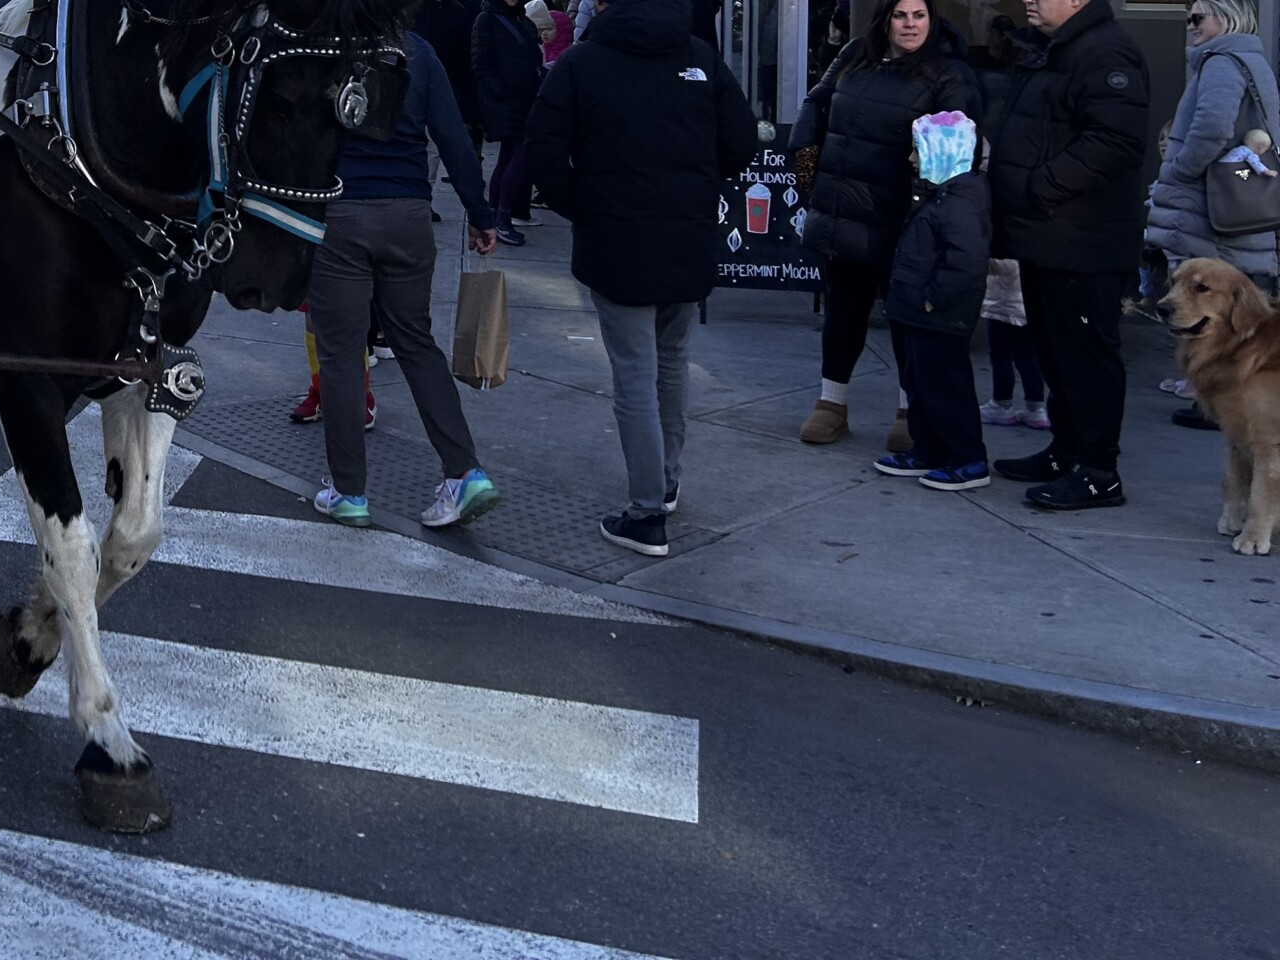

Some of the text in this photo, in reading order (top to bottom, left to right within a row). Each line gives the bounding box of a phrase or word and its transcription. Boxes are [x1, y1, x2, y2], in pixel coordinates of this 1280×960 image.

[763, 150, 786, 167] FOR
[740, 167, 797, 186] HOLIDAYS
[718, 262, 821, 281] EPPERMINT MOCHA
